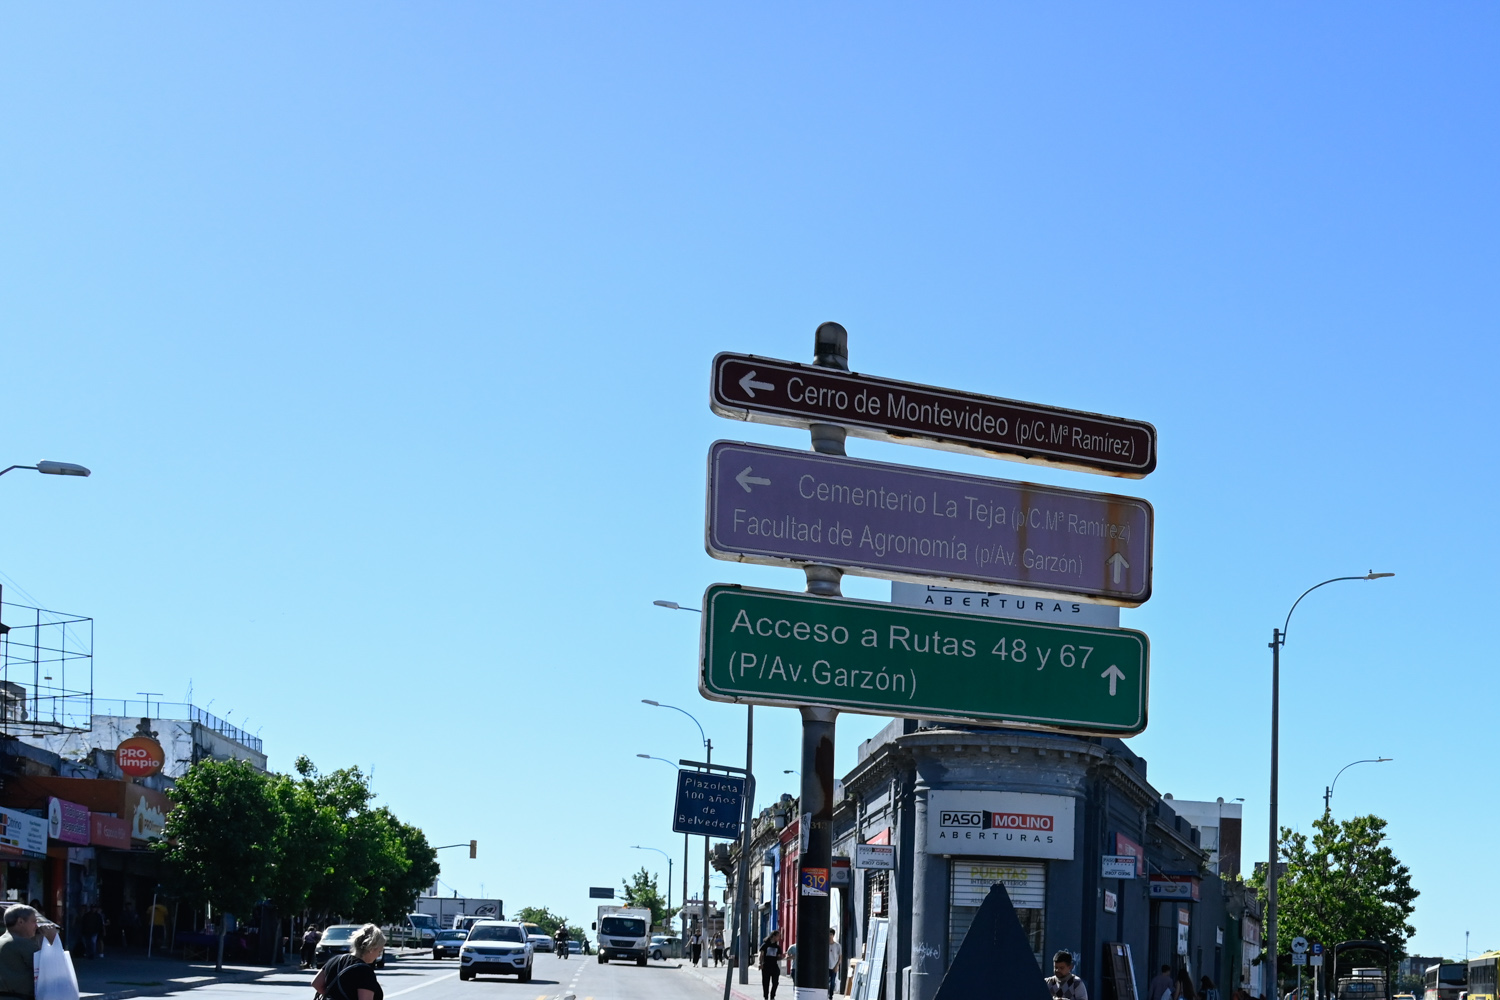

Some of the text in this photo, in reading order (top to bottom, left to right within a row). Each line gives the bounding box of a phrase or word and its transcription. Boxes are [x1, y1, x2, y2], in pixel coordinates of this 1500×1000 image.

[787, 377, 849, 411] Cerro
[854, 389, 881, 416] de
[887, 393, 1009, 436] Montevideo
[1072, 427, 1135, 462] Ramírez)
[798, 474, 926, 514] Cementerio
[933, 492, 958, 519] La
[964, 496, 1006, 530] Teja
[1068, 513, 1131, 545] Ramírez)
[733, 509, 1083, 579] Facultad de Agronomía (p/Av. Garzón)
[925, 594, 1080, 614] ABERTURAS
[730, 609, 1095, 672] Acceso a Rutas 48 y 67
[120, 748, 147, 758] PRO
[119, 757, 160, 769] limpio
[685, 777, 738, 793] Plazoleta
[685, 790, 736, 805] 100 años
[702, 806, 716, 815] de
[678, 814, 737, 830] Belvedere
[943, 813, 1051, 830] PASO MOLINO
[940, 831, 1054, 844] ABERTURAS
[970, 866, 1028, 880] PUERTAS
[805, 874, 826, 888] 319
[1313, 944, 1321, 954] E
